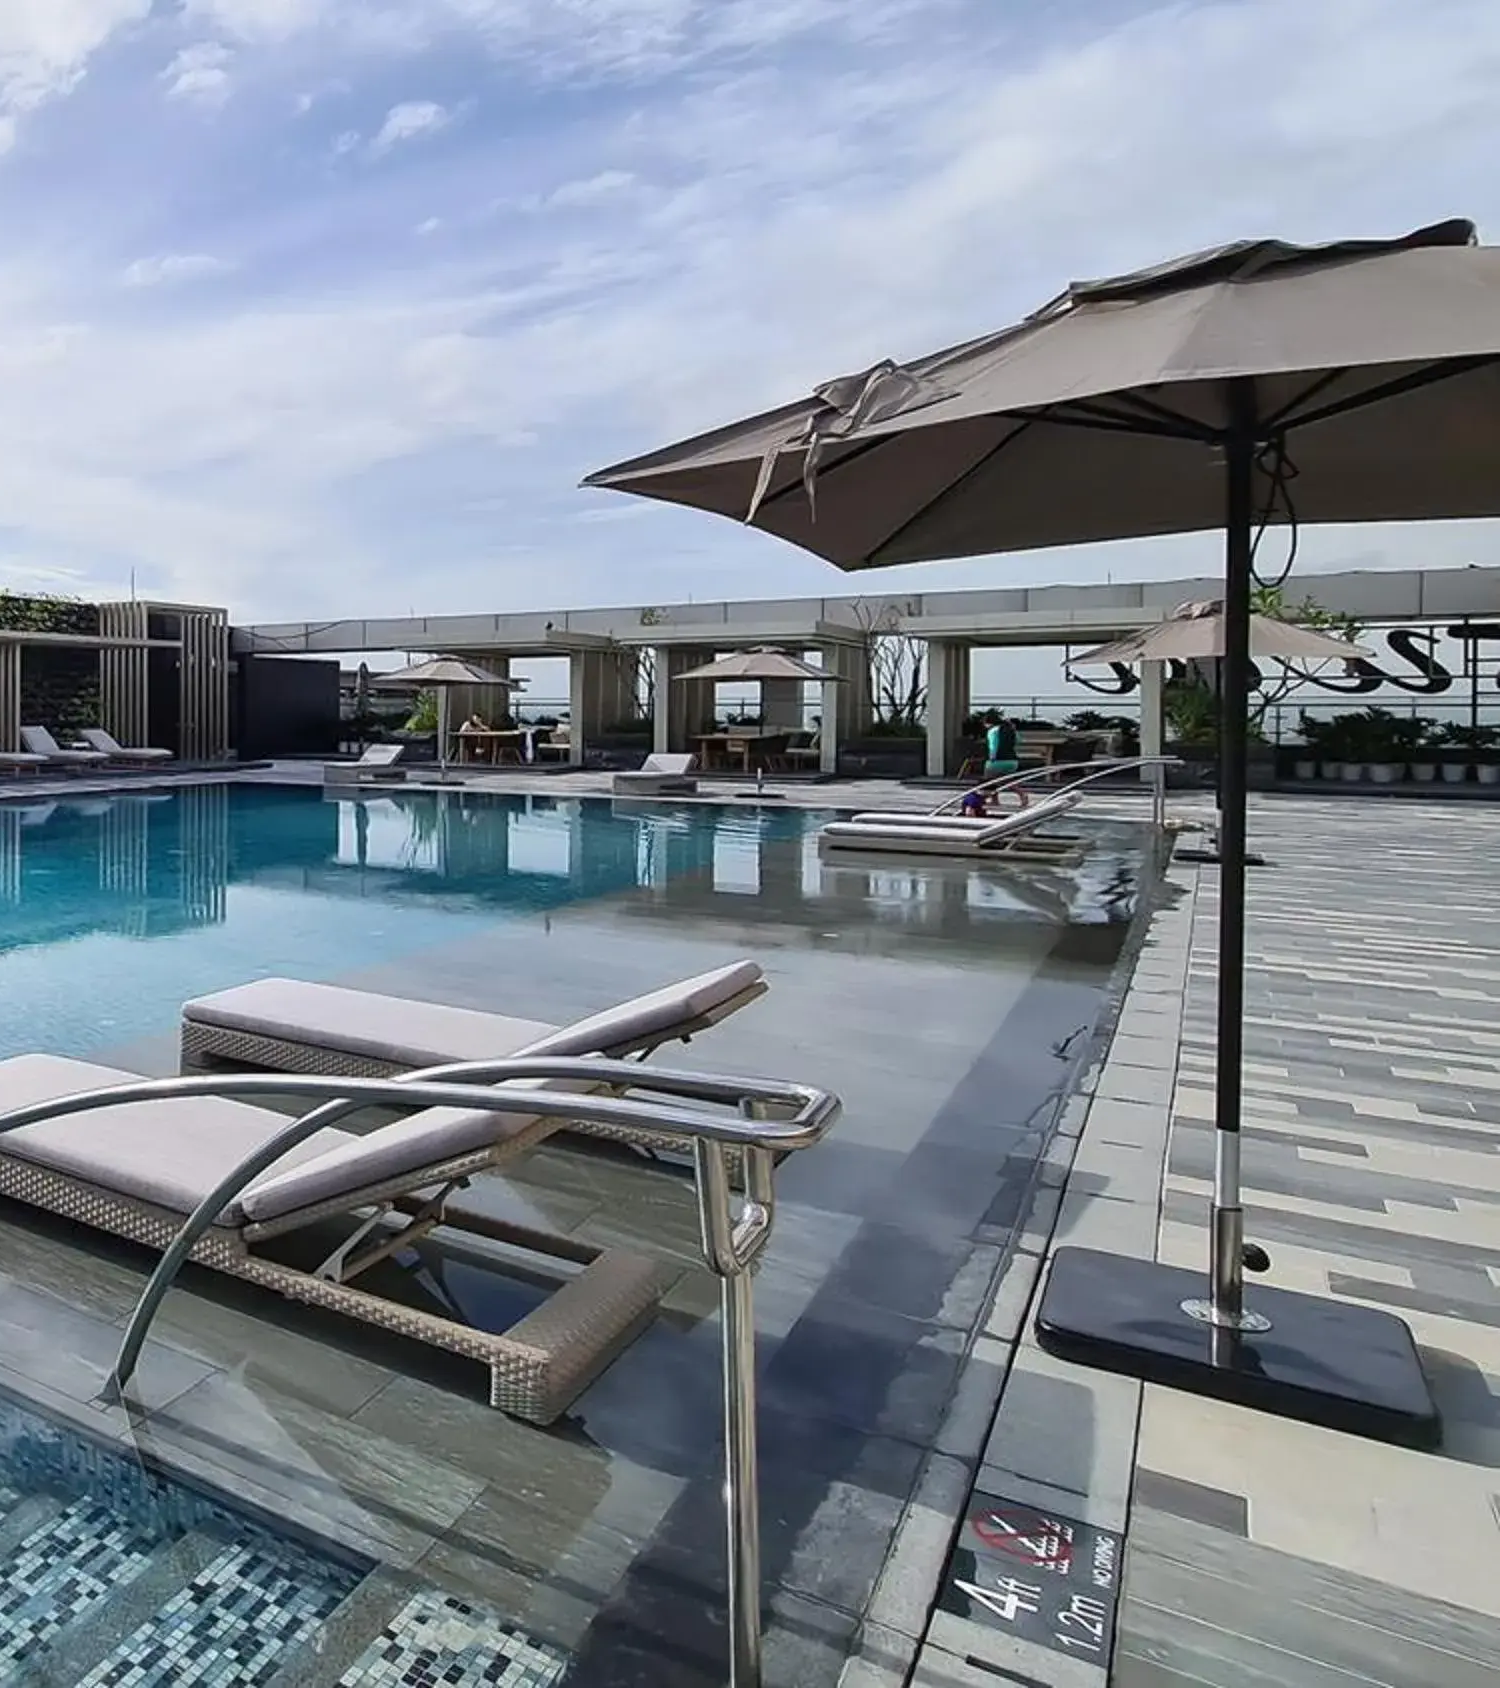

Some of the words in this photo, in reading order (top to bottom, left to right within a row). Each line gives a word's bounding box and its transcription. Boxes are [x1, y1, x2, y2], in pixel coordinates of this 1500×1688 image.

[1094, 1535, 1115, 1570] DIVING
[1091, 1568, 1112, 1589] NO
[1055, 1593, 1106, 1651] 1.2m
